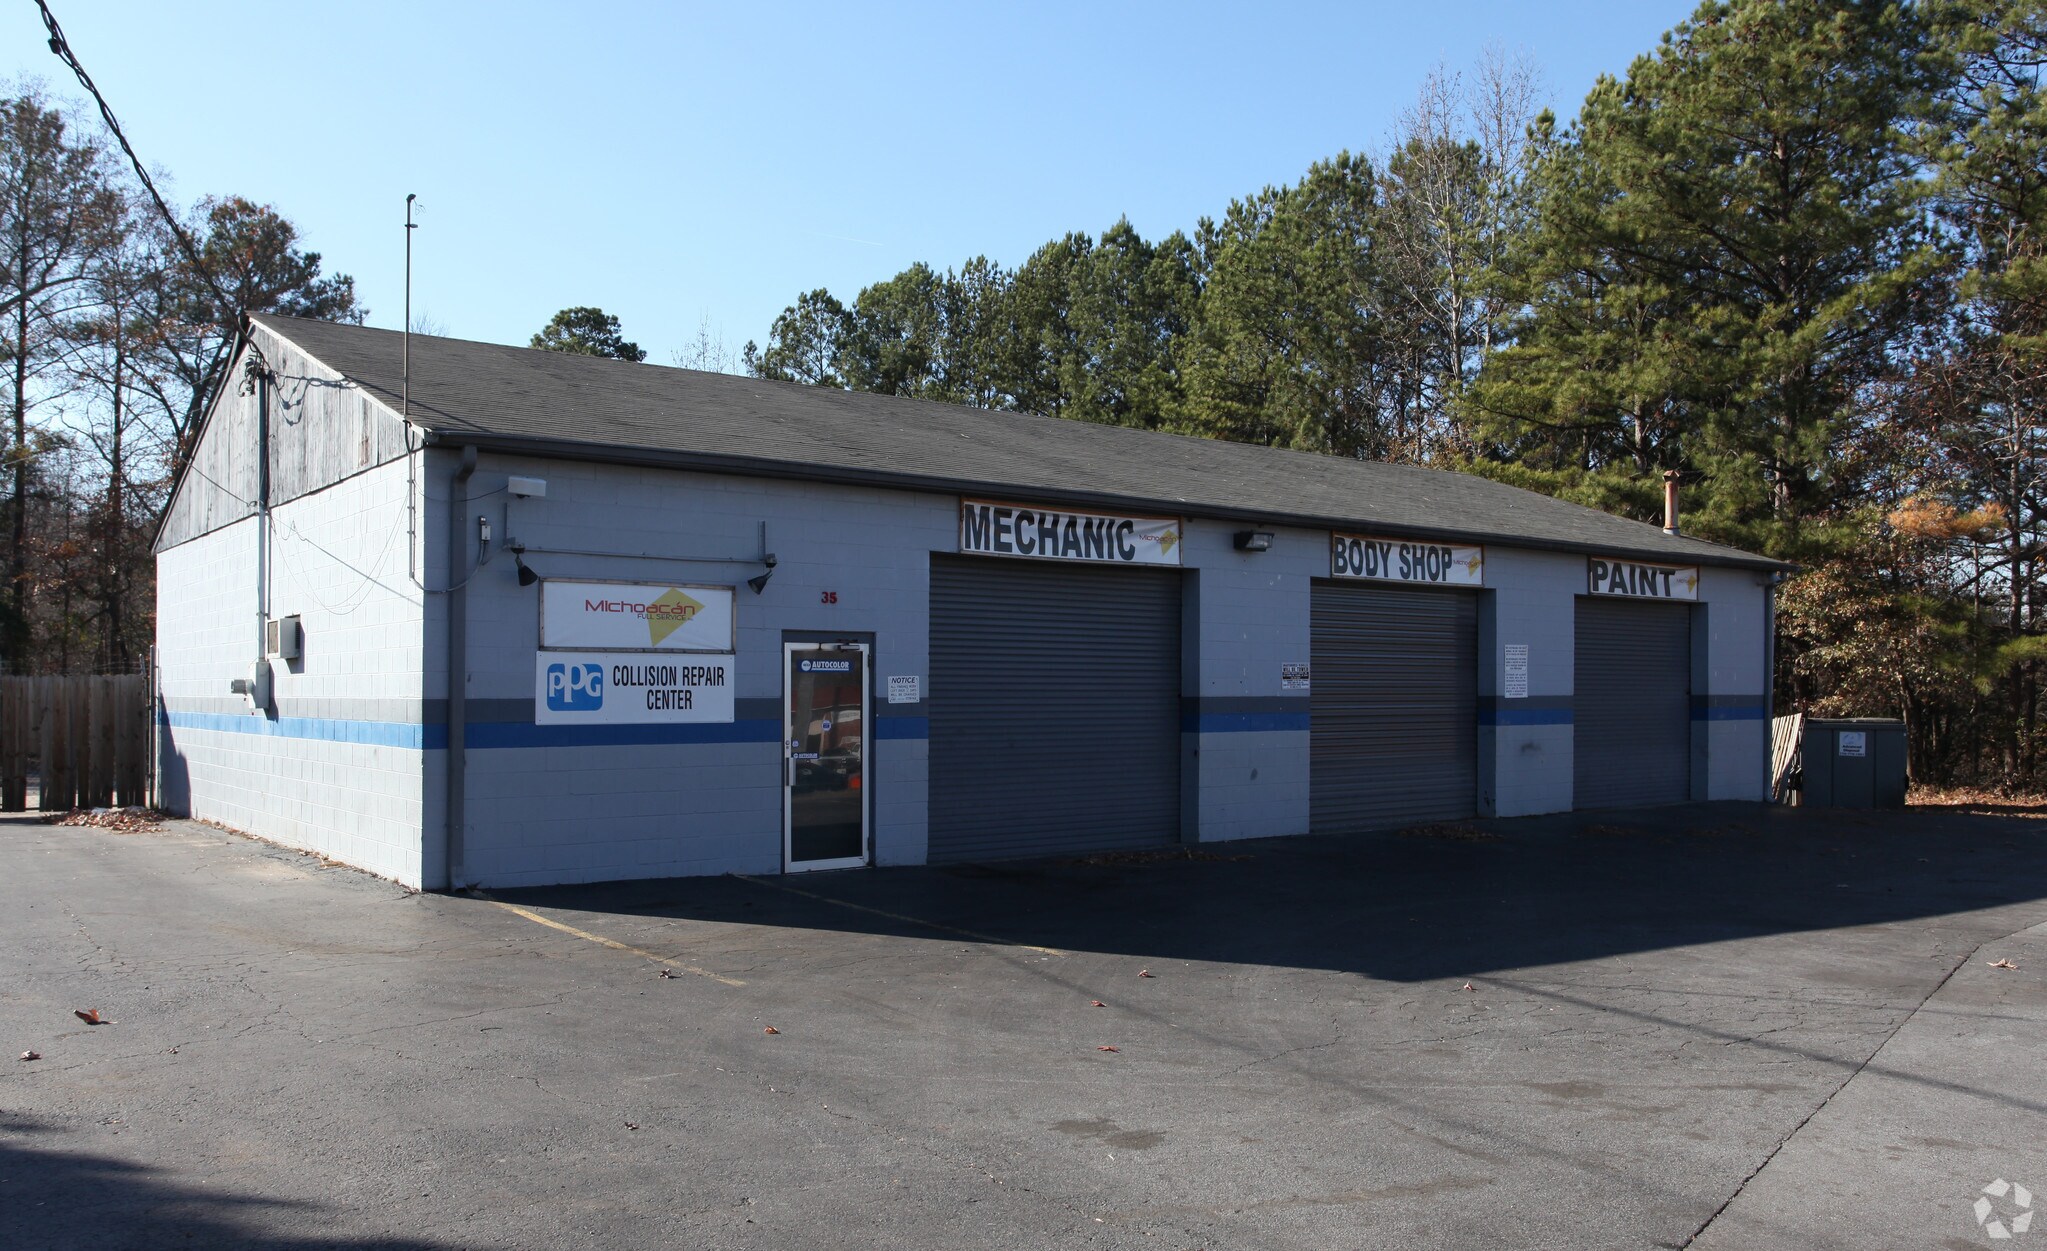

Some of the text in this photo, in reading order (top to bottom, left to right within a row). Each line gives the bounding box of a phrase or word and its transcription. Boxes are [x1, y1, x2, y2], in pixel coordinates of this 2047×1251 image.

[964, 504, 1136, 561] MECHANIC
[1334, 537, 1453, 581] BODY SHOP
[1592, 560, 1676, 597] PAINT
[585, 599, 695, 615] Michoacán
[821, 591, 838, 605] 35
[637, 613, 655, 621] FULL
[812, 660, 850, 669] AUTOCOLOR
[549, 663, 602, 703] PPG
[613, 665, 725, 687] COLLISION REPAIR
[646, 689, 693, 711] CENTER
